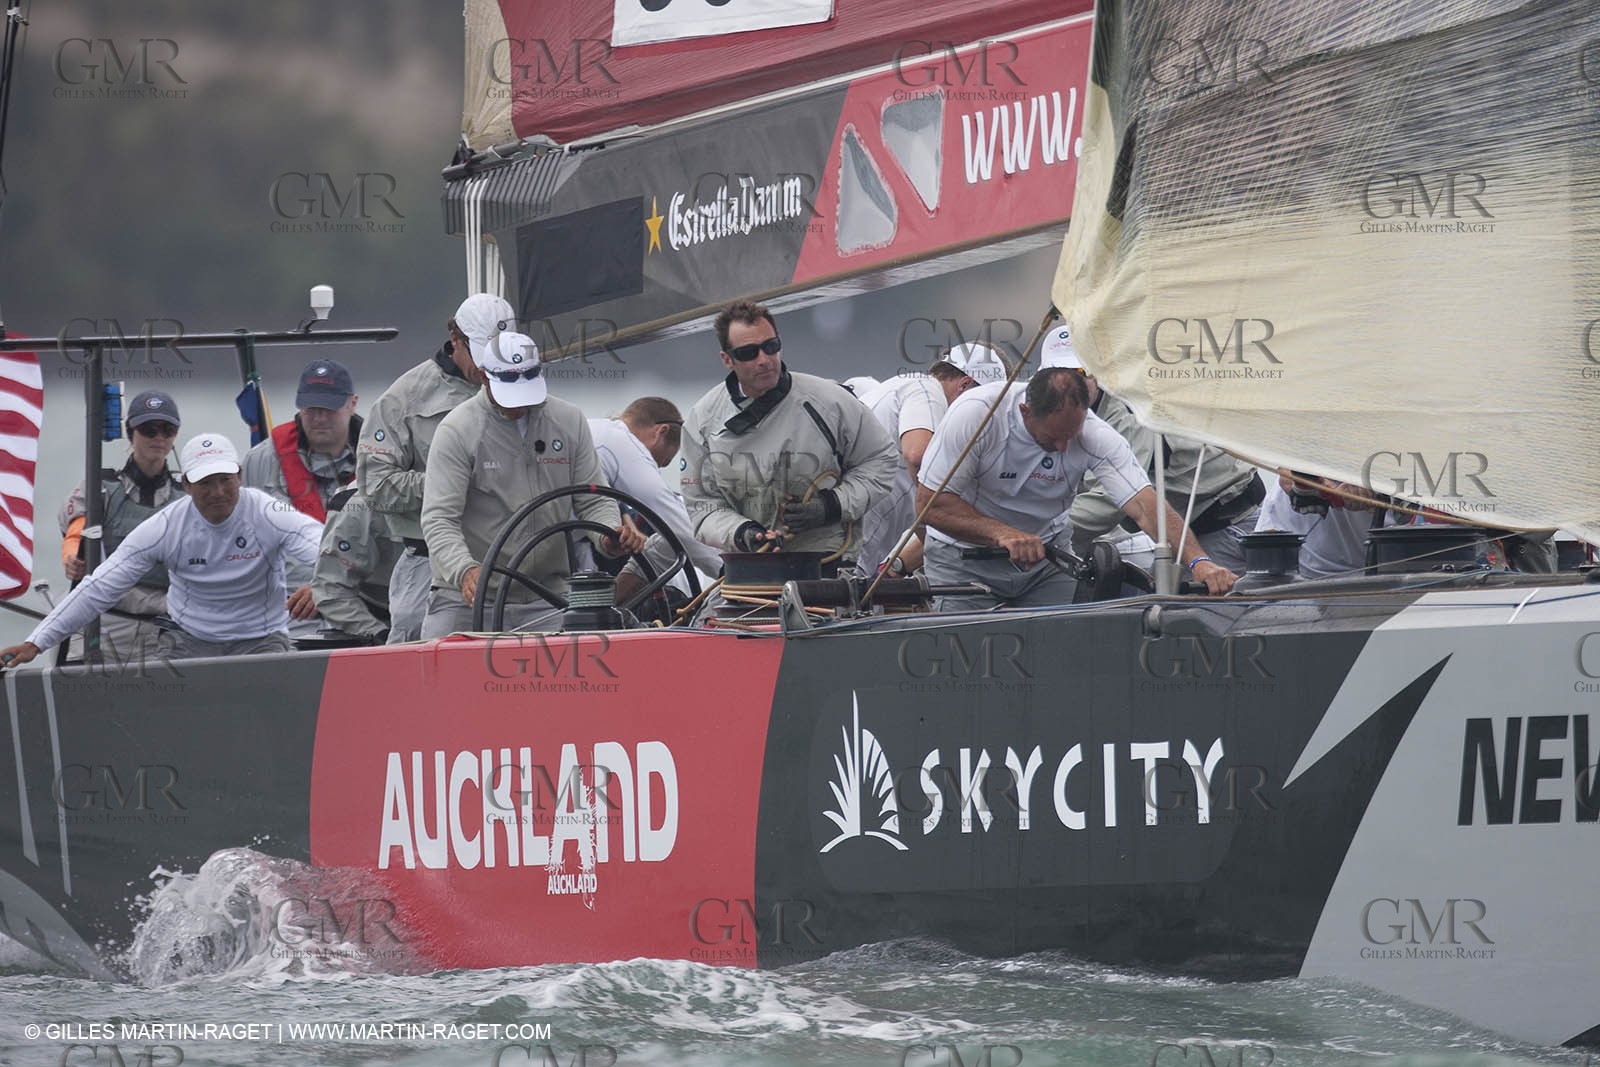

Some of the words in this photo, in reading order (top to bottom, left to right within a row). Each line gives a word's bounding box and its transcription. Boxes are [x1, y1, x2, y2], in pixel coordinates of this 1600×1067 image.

[669, 186, 738, 250] Estrella
[378, 741, 679, 870] AUCKLAND
[920, 737, 1225, 836] SKYCITY
[547, 873, 598, 895] AUCKLAND
